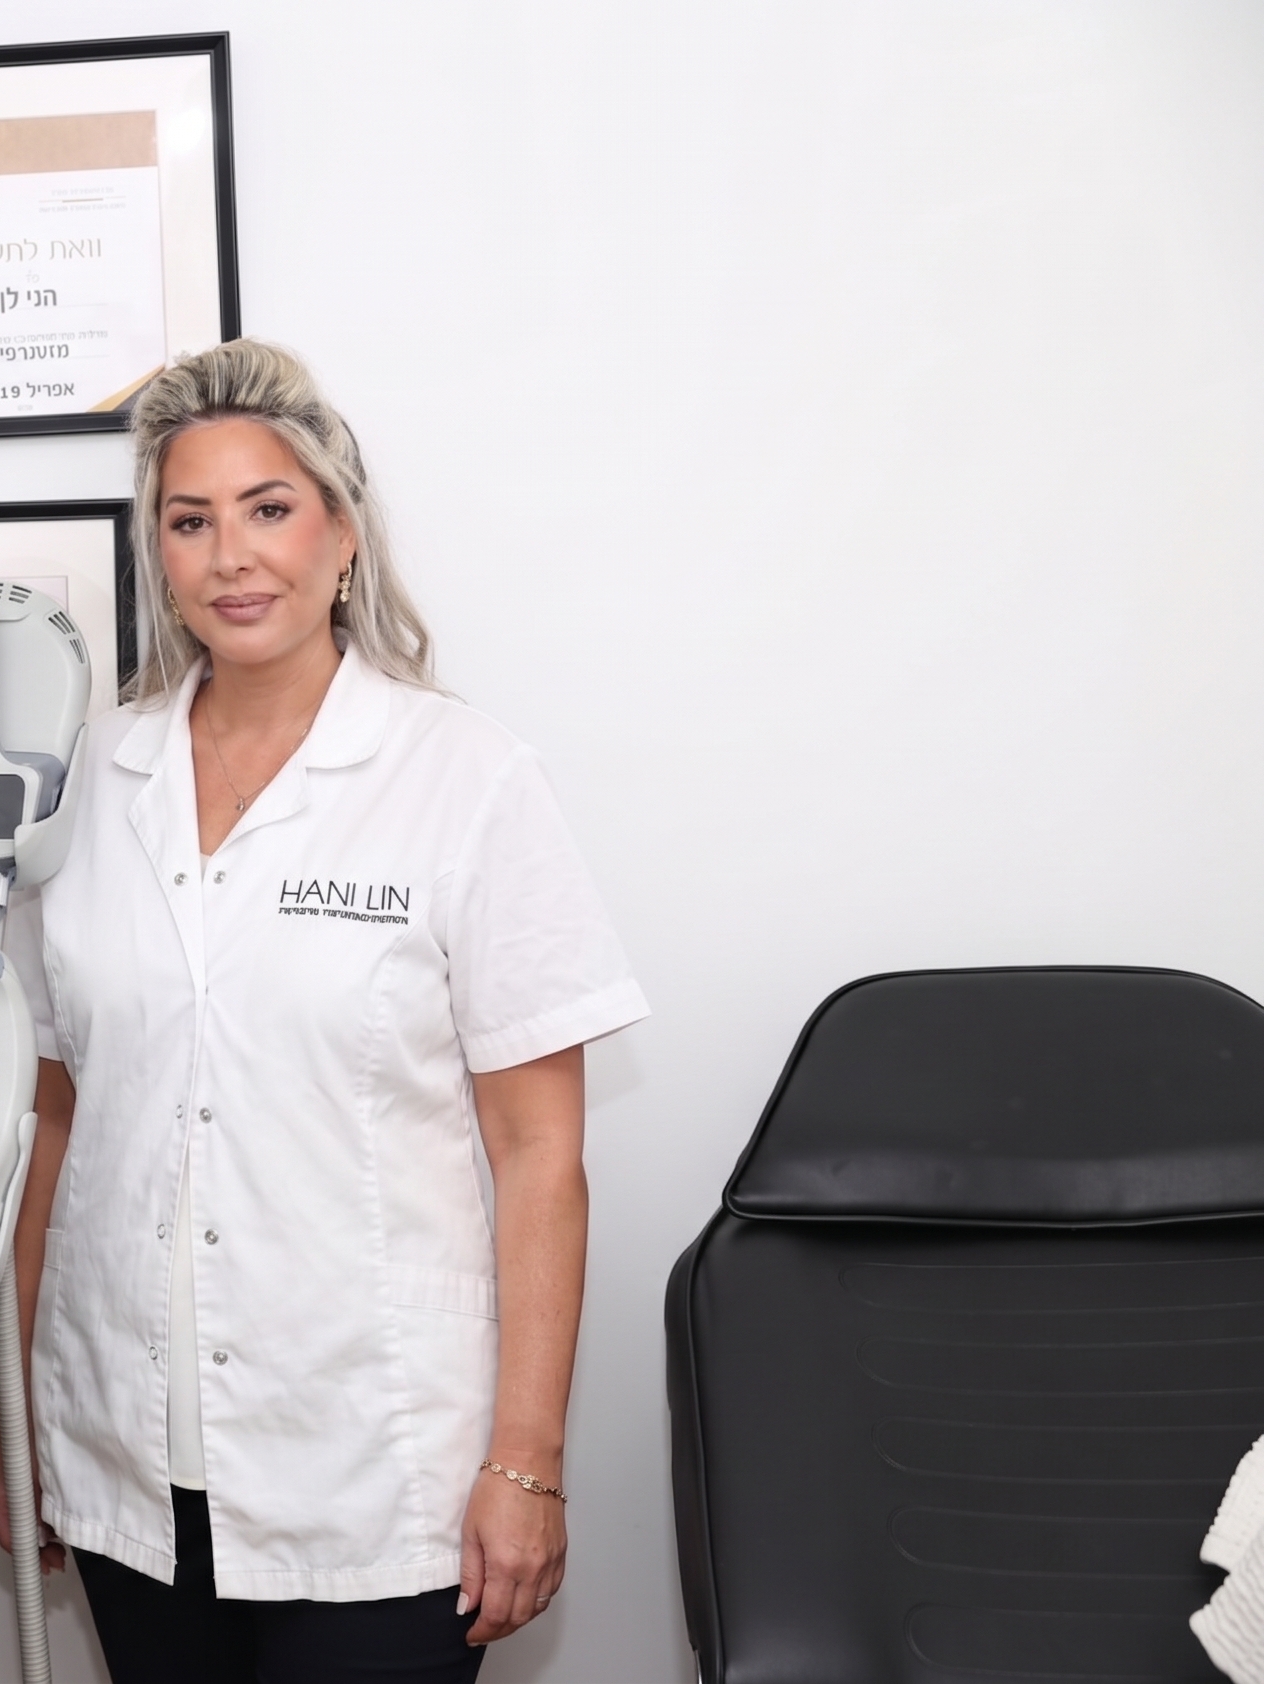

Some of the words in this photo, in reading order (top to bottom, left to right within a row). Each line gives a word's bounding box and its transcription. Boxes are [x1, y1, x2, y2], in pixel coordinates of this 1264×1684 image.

[0, 287, 19, 314] לן
[26, 289, 58, 307] הני
[26, 382, 75, 398] אפריל
[279, 879, 357, 907] HANI
[366, 884, 410, 912] LIN
